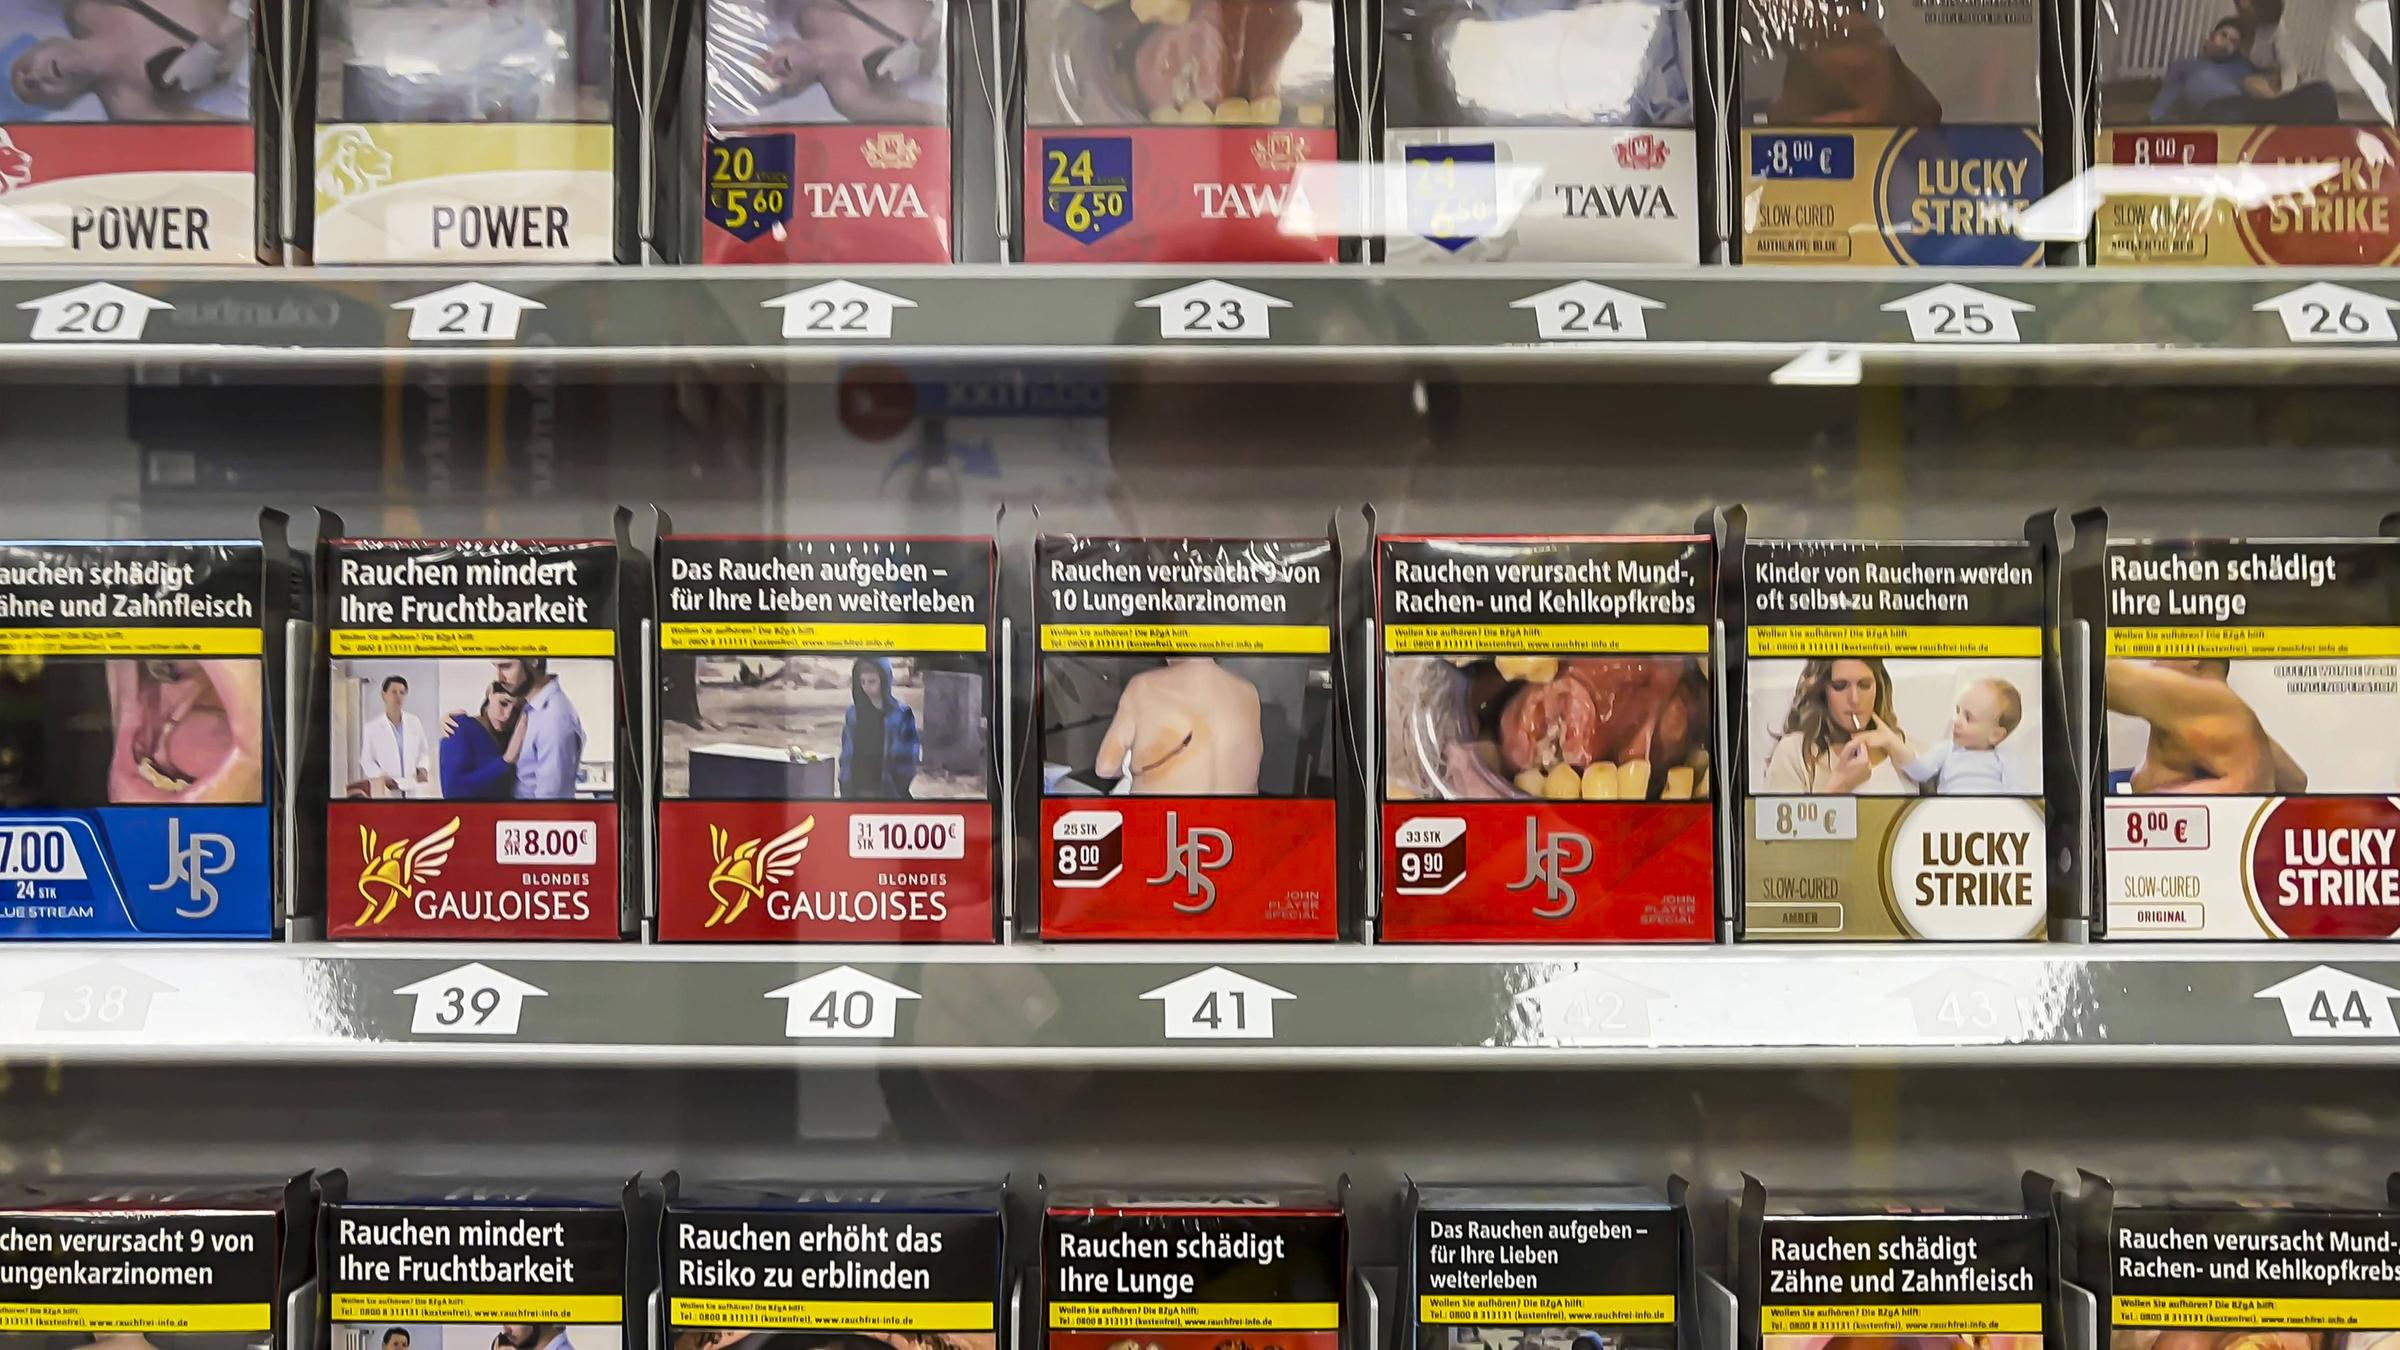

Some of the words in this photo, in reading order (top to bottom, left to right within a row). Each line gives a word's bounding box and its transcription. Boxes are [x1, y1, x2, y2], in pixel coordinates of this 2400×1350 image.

[712, 147, 753, 182] 20
[1048, 149, 1093, 185] 24
[1918, 158, 2027, 195] LUCKY
[804, 182, 928, 218] TAWA
[1193, 182, 1318, 219] TAWA
[1555, 184, 1679, 219] TAWA
[72, 206, 209, 250] POWER
[433, 205, 569, 249] POWER
[1759, 203, 1835, 228] SLOW-CURED
[58, 303, 123, 333] 20
[439, 303, 493, 332] 21
[806, 301, 870, 330] 22
[1184, 300, 1246, 331] 23
[1558, 301, 1623, 332] 24
[1928, 304, 1994, 334] 25
[2302, 303, 2370, 333] 26
[0, 561, 84, 585] auchen
[90, 560, 194, 590] schädigt
[342, 558, 457, 585] Rauchen
[465, 558, 577, 585] mindert
[672, 559, 712, 581] Das
[719, 558, 814, 582] Rauchen
[820, 558, 927, 587] aufgeben
[1052, 560, 1142, 583] Rauchen
[1147, 560, 1258, 584] verursacht
[1283, 564, 1320, 584] von
[1396, 559, 1489, 582] Rauchen
[1494, 559, 1611, 583] verursacht
[1618, 559, 1695, 588] Mund-,
[1757, 562, 1819, 584] Kinder
[1825, 567, 1860, 584] von
[1865, 562, 1955, 585] Rauchern
[1960, 563, 2033, 585] werden
[2111, 555, 2219, 582] Rauchen
[2227, 554, 2336, 584] schädigt
[60, 593, 106, 618] und
[112, 592, 252, 619] Zahnfleisch
[341, 594, 394, 623] Ihre
[402, 594, 588, 624] Fruchtbarkeit
[671, 587, 703, 611] für
[708, 587, 752, 611] Ihre
[758, 587, 833, 612] Lieben
[837, 587, 974, 613] weiterleben
[1052, 588, 1077, 611] 10
[1083, 587, 1286, 616] Lungenkarzinomen
[1396, 589, 1484, 613] Rachen-
[1490, 589, 1532, 613] und
[1538, 589, 1696, 618] Kehlkopfkrebs
[1757, 588, 1785, 610] oft
[1790, 588, 1847, 610] selbst
[1851, 593, 1873, 610] zu
[1879, 589, 1969, 611] Rauchern
[2112, 589, 2162, 615] Ihre
[2169, 588, 2247, 620] Lunge
[1064, 823, 1078, 835] 25
[1081, 823, 1098, 835] STK
[1776, 802, 1819, 838] 8,00
[1824, 809, 1837, 834] €
[2126, 811, 2168, 848] 8,00
[2174, 820, 2188, 842] €
[0, 831, 65, 873] 7.00
[1407, 831, 1421, 843] 33
[1424, 831, 1441, 843] STK
[1922, 832, 2031, 866] LUCKY
[2284, 828, 2396, 866] LUCKY
[16, 881, 35, 900] 24
[38, 887, 57, 899] STK
[522, 872, 590, 886] BLONDES
[878, 872, 947, 886] BLONDES
[1763, 877, 1839, 900] SLOW-CURED
[1915, 871, 2033, 907] STRIKE
[2124, 875, 2201, 898] SLOW-CURED
[2278, 868, 2400, 907] STRIKE
[414, 890, 590, 922] GAULOISES
[766, 890, 948, 923] GAULOISES
[1268, 901, 1320, 910] PLAYER
[1286, 890, 1320, 901] JOHN
[29, 906, 94, 919] STREAM
[2137, 910, 2187, 923] ORIGINAL
[63, 984, 126, 1023] 38
[436, 987, 501, 1025] 39
[809, 991, 874, 1029] 40
[1192, 991, 1246, 1030] 41
[2309, 990, 2372, 1028] 44
[0, 1227, 53, 1252] chen
[60, 1227, 184, 1253] verursacht
[190, 1228, 205, 1253] 9
[211, 1234, 254, 1253] von
[341, 1218, 451, 1246] Rauchen
[459, 1219, 565, 1247] mindert
[679, 1223, 791, 1251] Rauchen
[799, 1223, 889, 1253] erhöht
[896, 1223, 943, 1253] das
[1431, 1221, 1464, 1239] Das
[1468, 1220, 1544, 1240] Rauchen
[1548, 1220, 1632, 1244] aufgeben
[2120, 1227, 2208, 1250] Rauchen
[2214, 1229, 2325, 1252] verursacht
[1061, 1232, 1168, 1259] Rauchen
[1176, 1231, 1285, 1264] schädigt
[1430, 1244, 1455, 1264] für
[1460, 1244, 1495, 1264] Ihre
[1500, 1244, 1559, 1265] Lieben
[1771, 1236, 1871, 1261] Rauchen
[1878, 1235, 1978, 1266] schädigt
[0, 1259, 213, 1290] ungenkarzinomen
[341, 1254, 391, 1281] Ihre
[398, 1254, 574, 1283] Fruchtbarkeit
[679, 1259, 756, 1287] Risiko
[763, 1267, 793, 1288] zu
[801, 1260, 930, 1290] erblinden
[1061, 1266, 1109, 1292] Ihre
[1116, 1266, 1194, 1300] Lunge
[1430, 1269, 1537, 1289] weiterleben
[1771, 1268, 1844, 1293] Zähne
[1850, 1268, 1895, 1293] und
[1901, 1266, 2033, 1292] Zahnfleisch
[2120, 1256, 2204, 1279] Rachen-
[2209, 1257, 2250, 1280] und
[2255, 1257, 2400, 1286] Kehlkopfkrebs
[1430, 1298, 1460, 1307] Wollen
